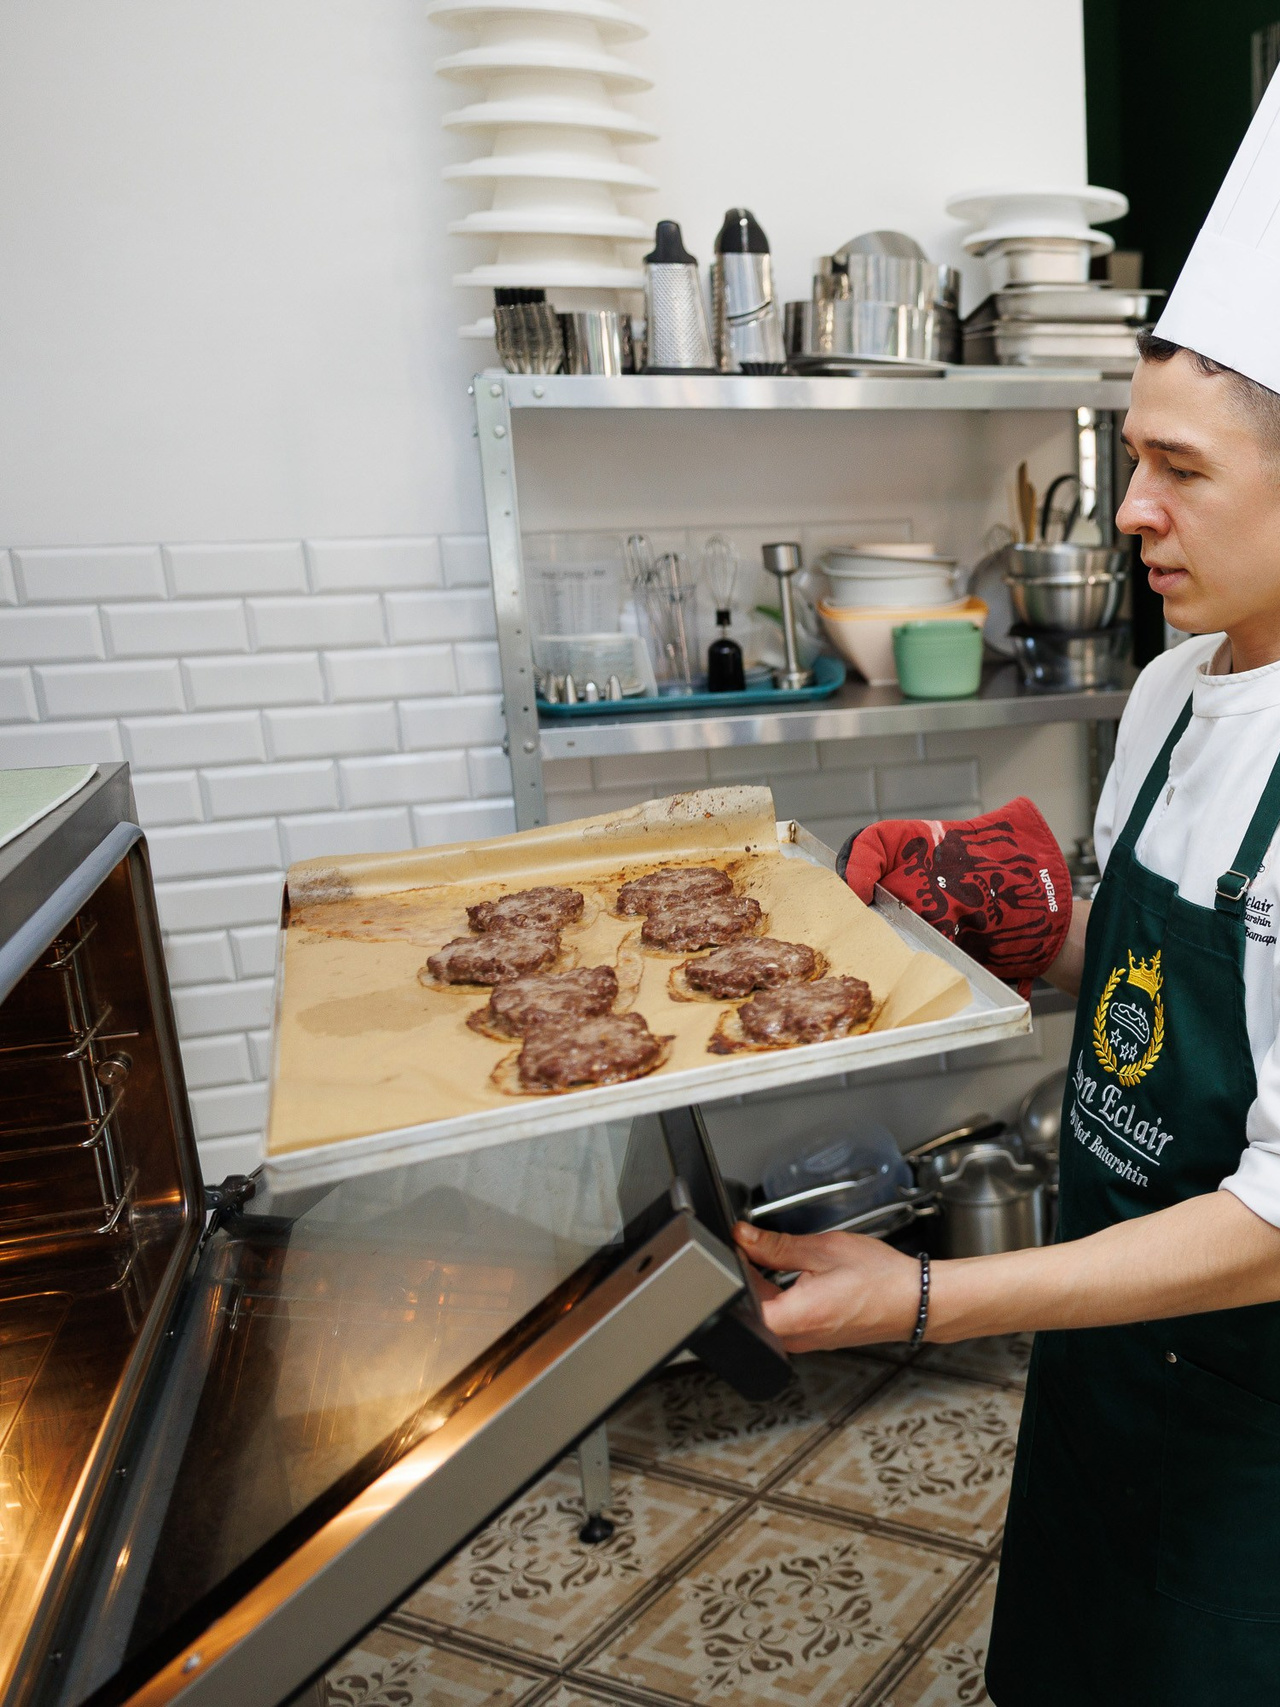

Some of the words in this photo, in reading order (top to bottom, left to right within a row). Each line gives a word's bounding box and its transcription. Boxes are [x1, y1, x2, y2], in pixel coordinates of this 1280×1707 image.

[1039, 868, 1058, 912] SWEDEN
[1246, 896, 1274, 913] clair
[1098, 1084, 1174, 1157] Eclair
[1087, 1134, 1149, 1188] Batarshin
